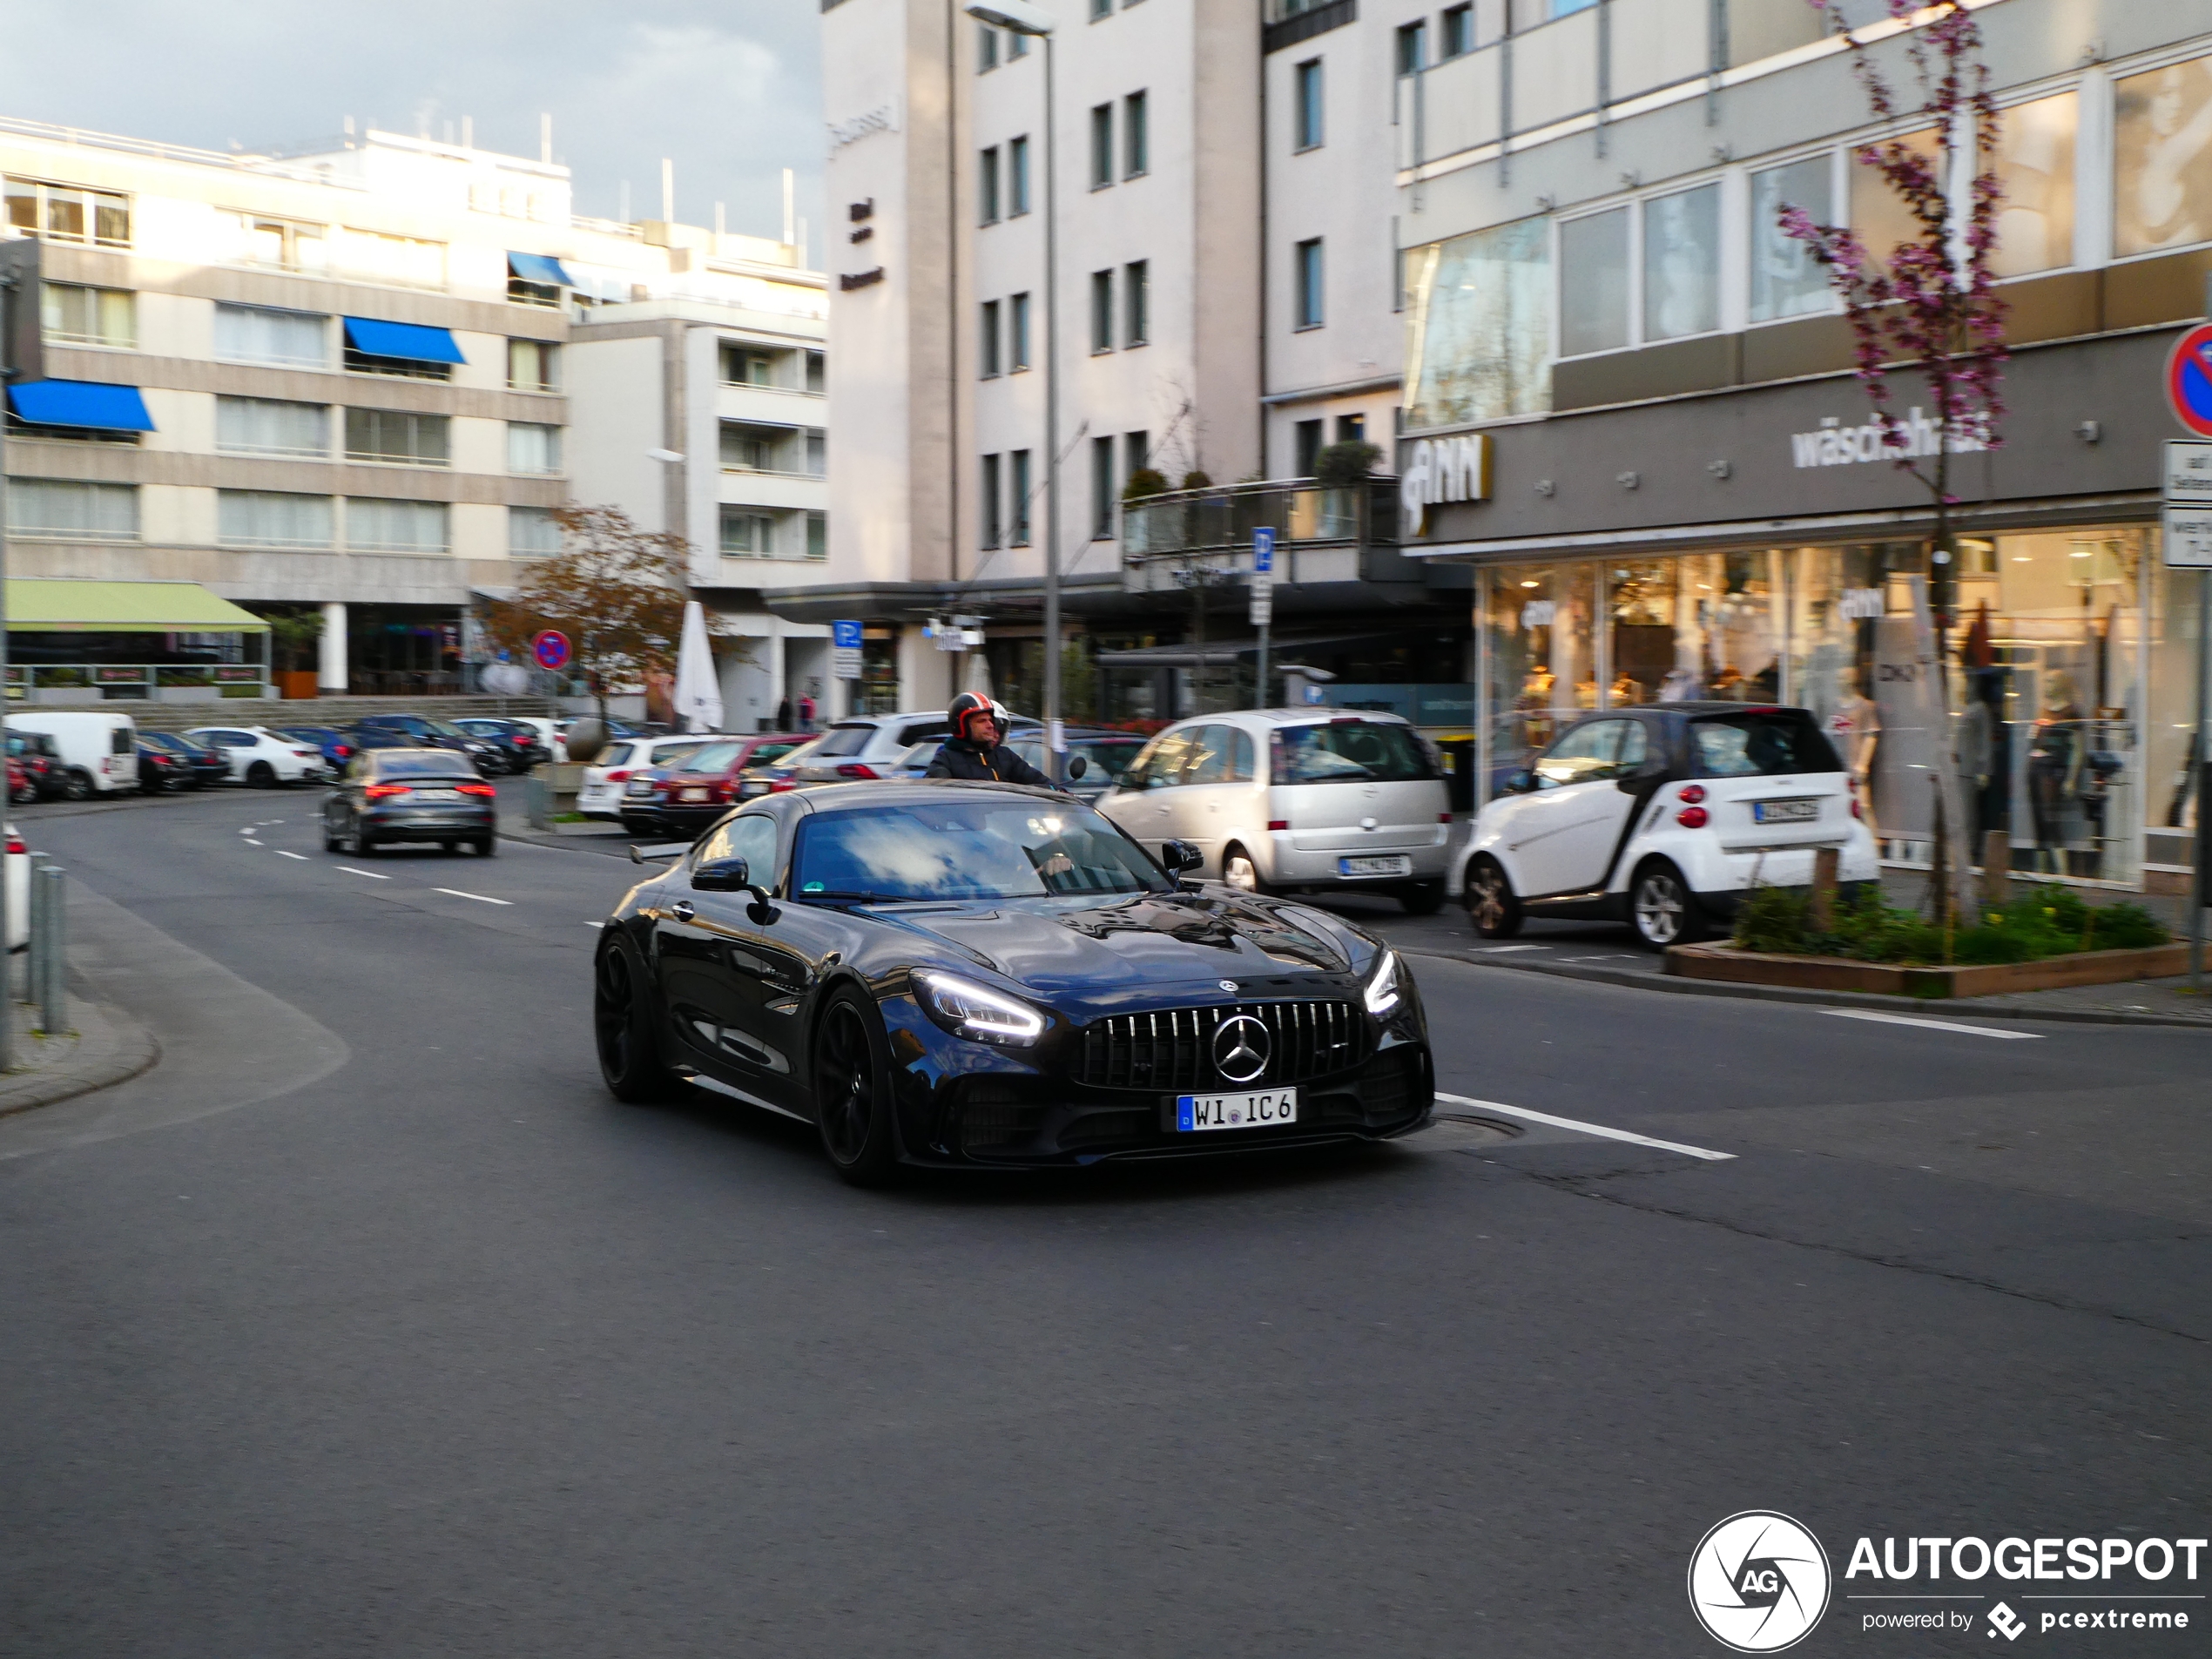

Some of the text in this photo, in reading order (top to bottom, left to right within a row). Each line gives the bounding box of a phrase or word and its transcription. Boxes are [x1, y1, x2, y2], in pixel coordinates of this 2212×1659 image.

[1195, 1100, 1225, 1125] WI
[1247, 1096, 1272, 1122] IC
[1278, 1094, 1291, 1118] 6
